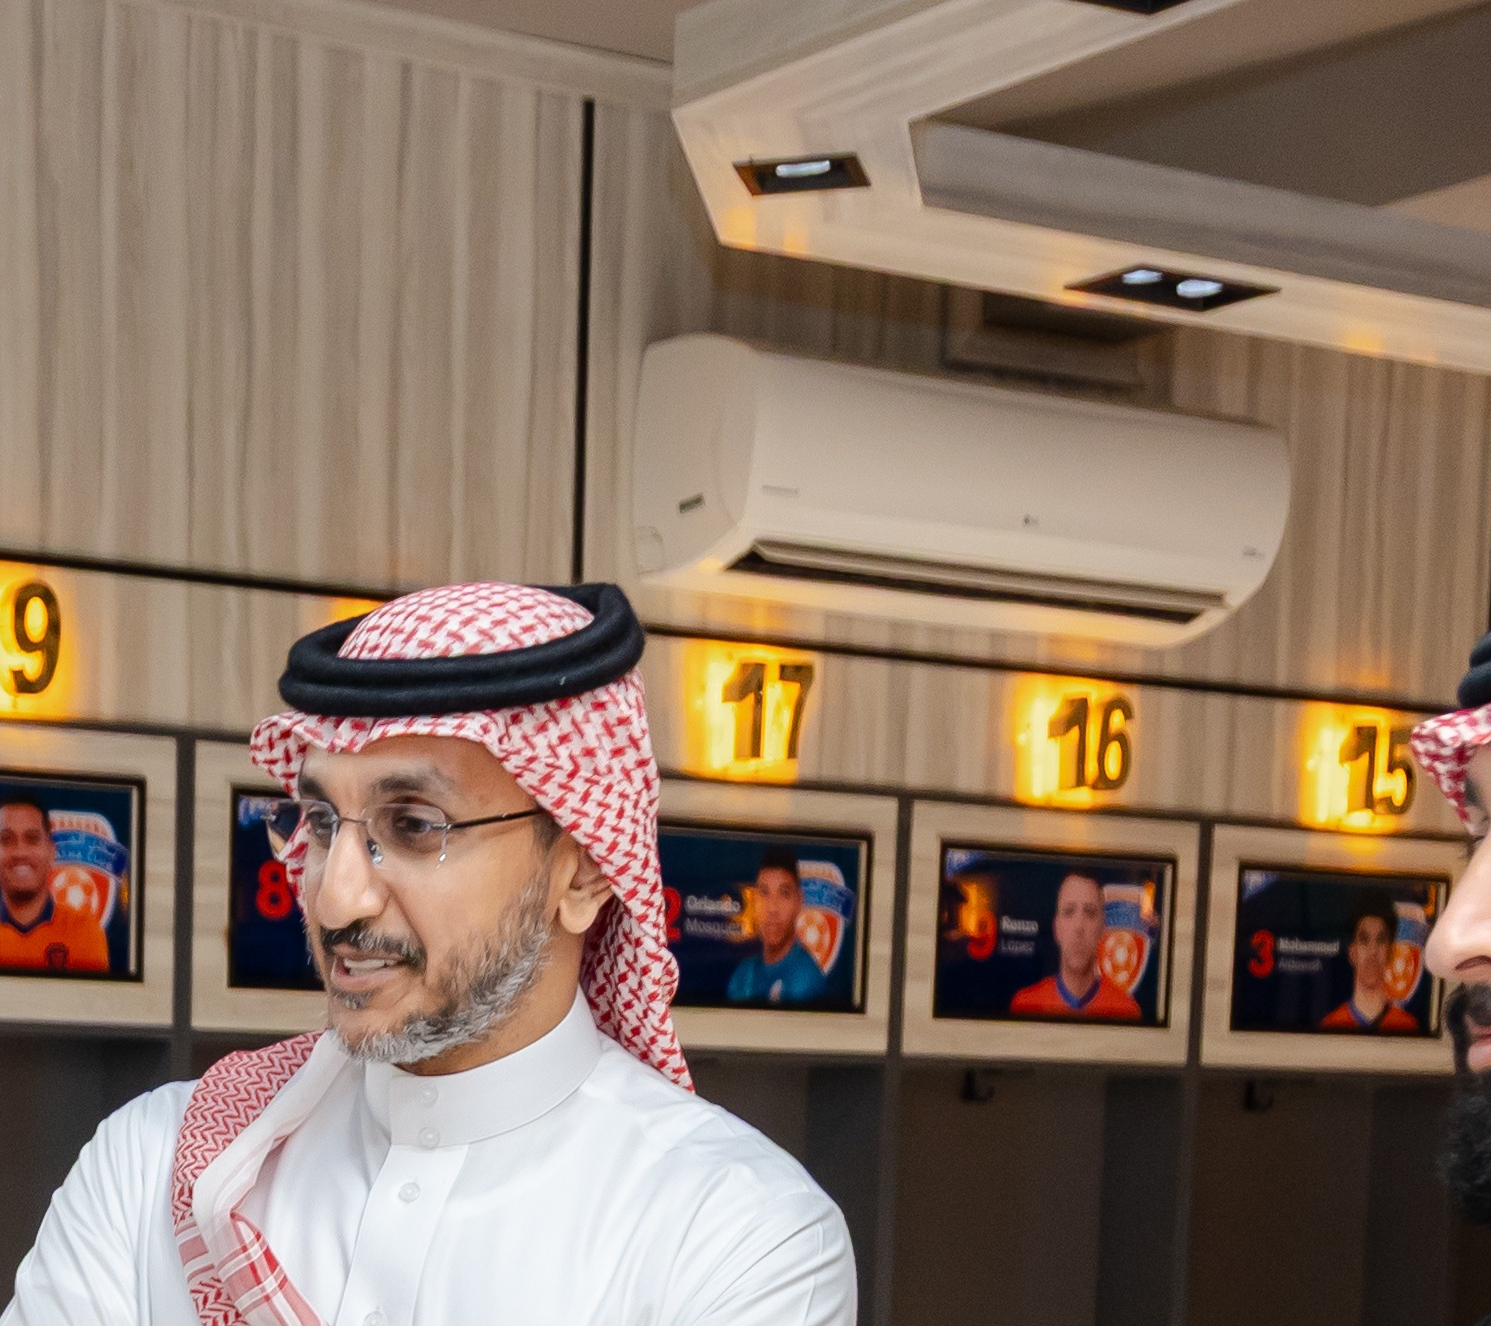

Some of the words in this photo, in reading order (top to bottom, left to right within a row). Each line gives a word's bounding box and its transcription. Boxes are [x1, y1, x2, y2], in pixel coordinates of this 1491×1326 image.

[724, 662, 815, 761] 17
[1049, 696, 1135, 791] 16
[1340, 725, 1417, 816] 15
[255, 859, 293, 921] 8
[684, 893, 742, 917] Orlando
[1247, 929, 1275, 979] 3
